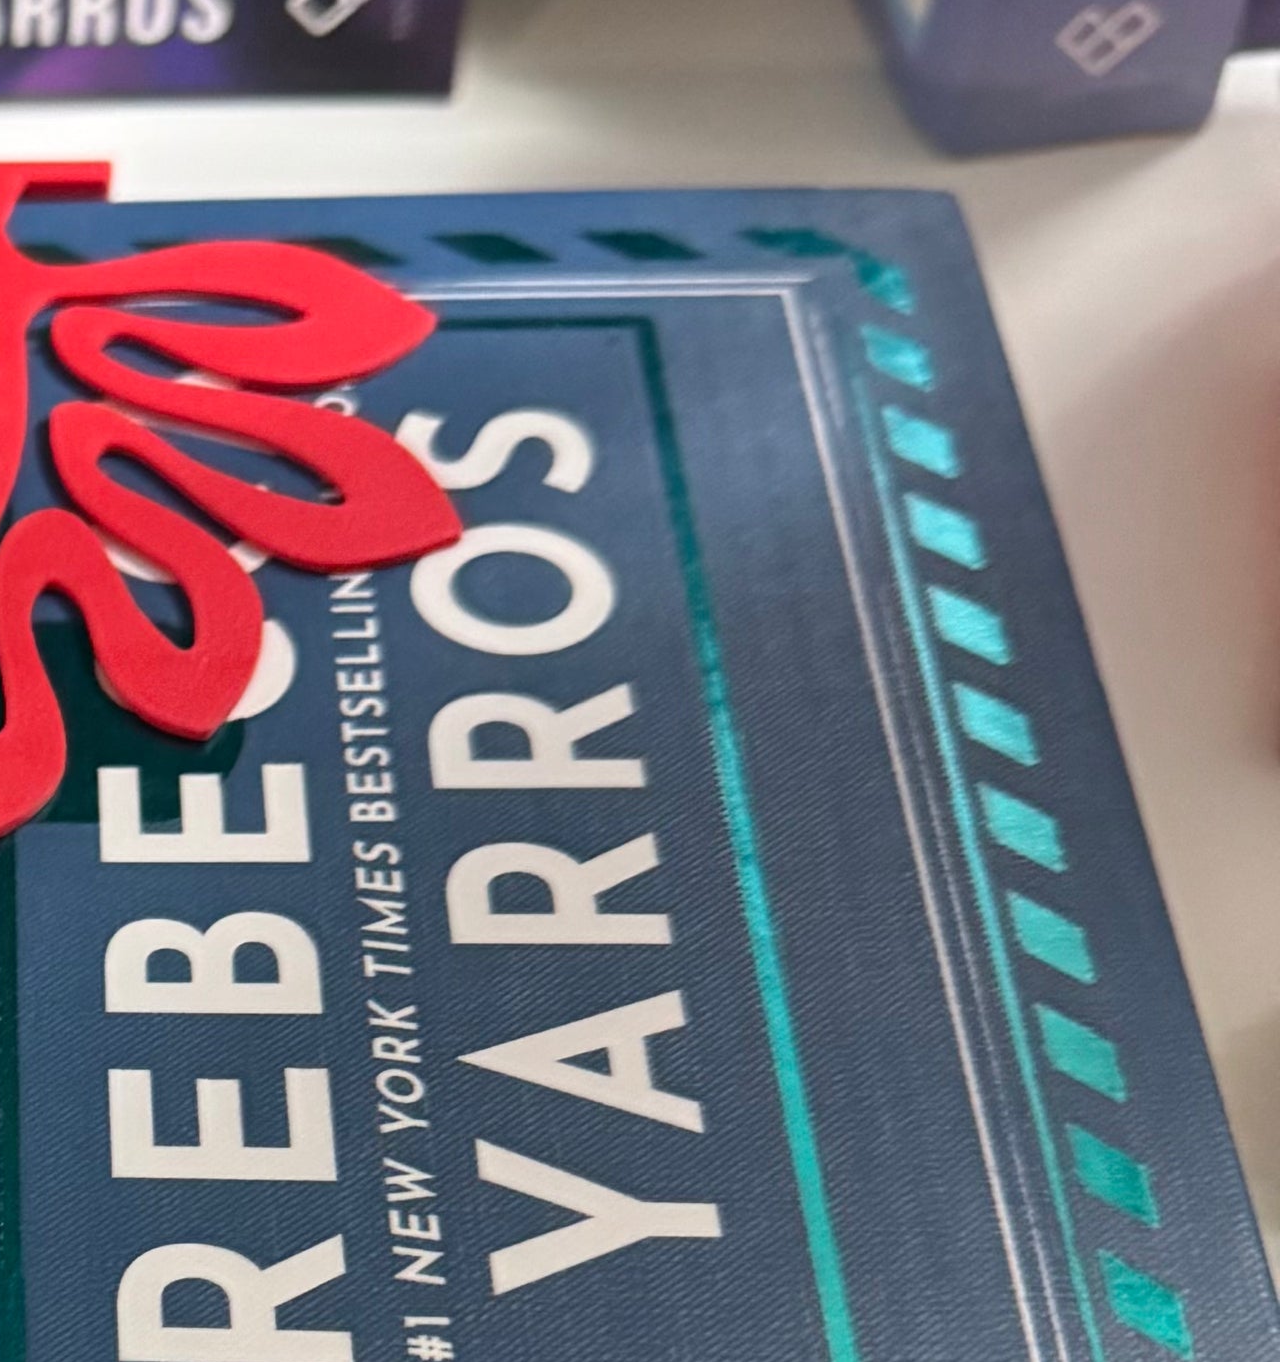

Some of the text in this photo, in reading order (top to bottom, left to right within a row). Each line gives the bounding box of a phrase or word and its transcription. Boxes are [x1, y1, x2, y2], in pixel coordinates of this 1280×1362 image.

[327, 570, 456, 1362] #1 NEW YORK TIMES BESTSELLIN
[395, 409, 723, 1296] YARROS
